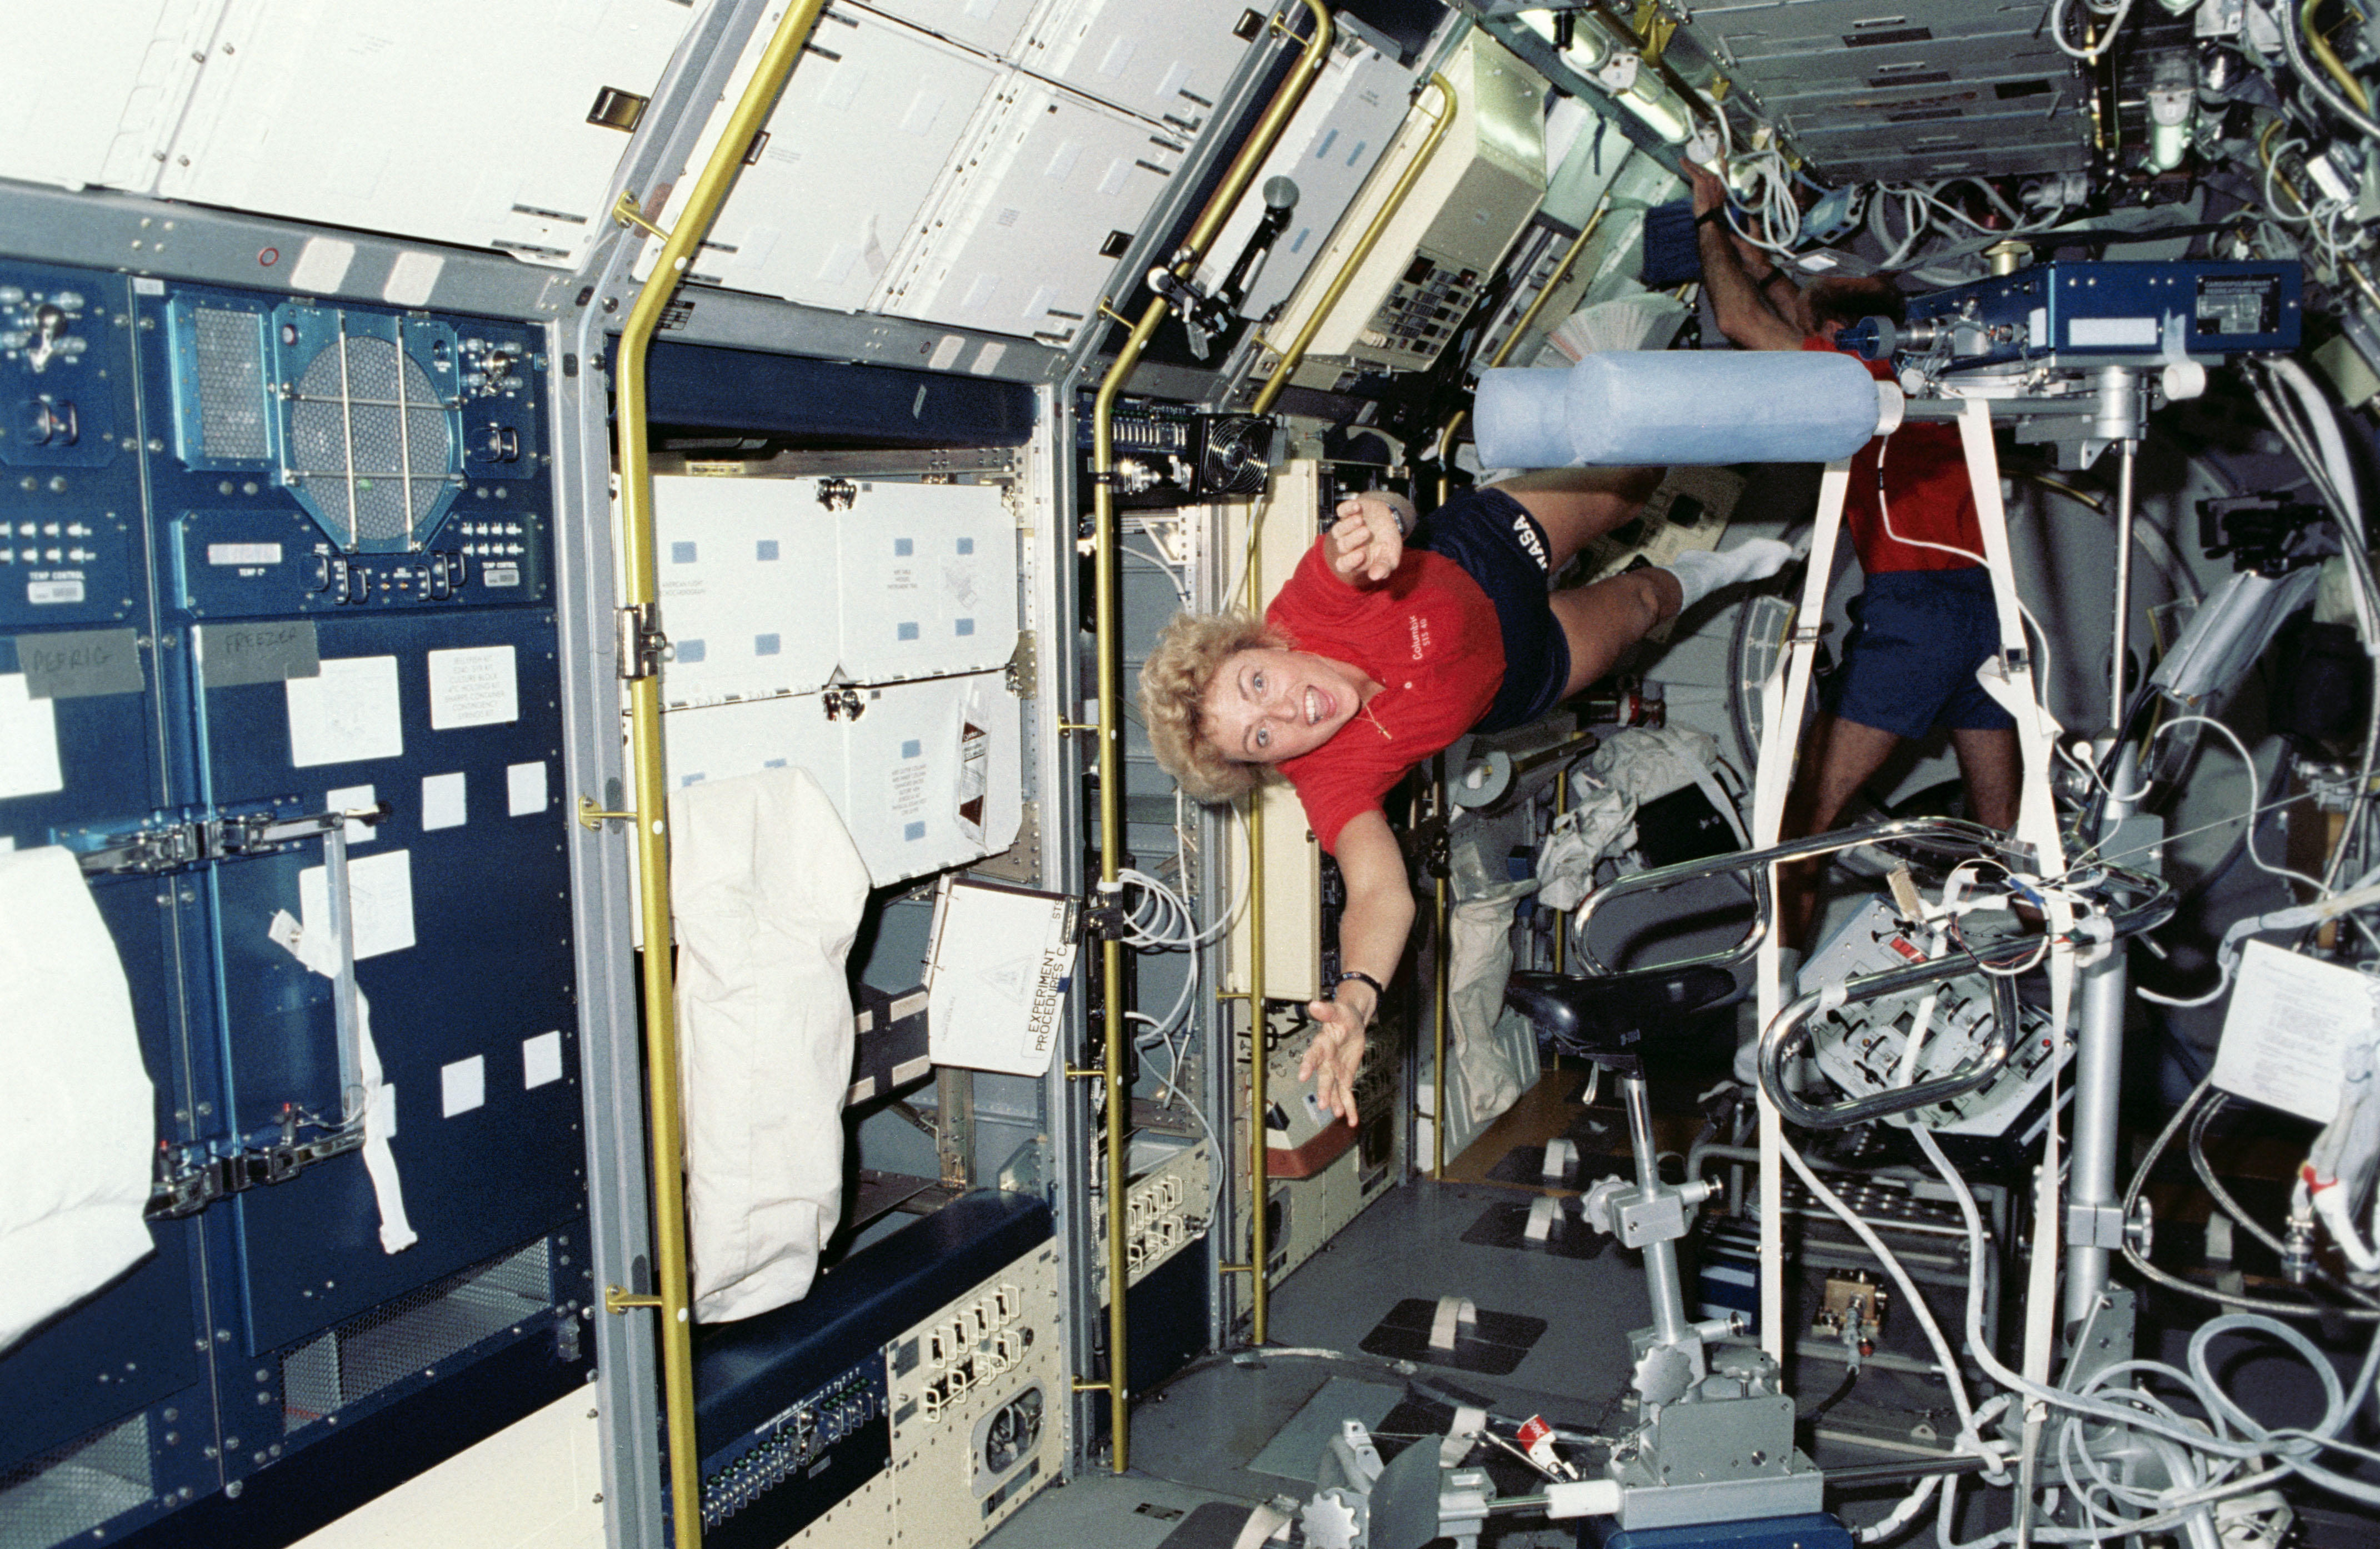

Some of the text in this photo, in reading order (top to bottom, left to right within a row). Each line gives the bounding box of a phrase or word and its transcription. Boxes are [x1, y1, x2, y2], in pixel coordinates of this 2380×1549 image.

[1513, 514, 1548, 573] NASA
[29, 569, 86, 580] TEMP CONTROL
[238, 567, 256, 577] TEMP
[226, 627, 297, 654] FREEZER
[1421, 632, 1431, 646] STS
[1052, 900, 1064, 920] STS
[1028, 948, 1056, 1033] EXPERIMENT
[1036, 963, 1064, 1052] PROCEDURES
